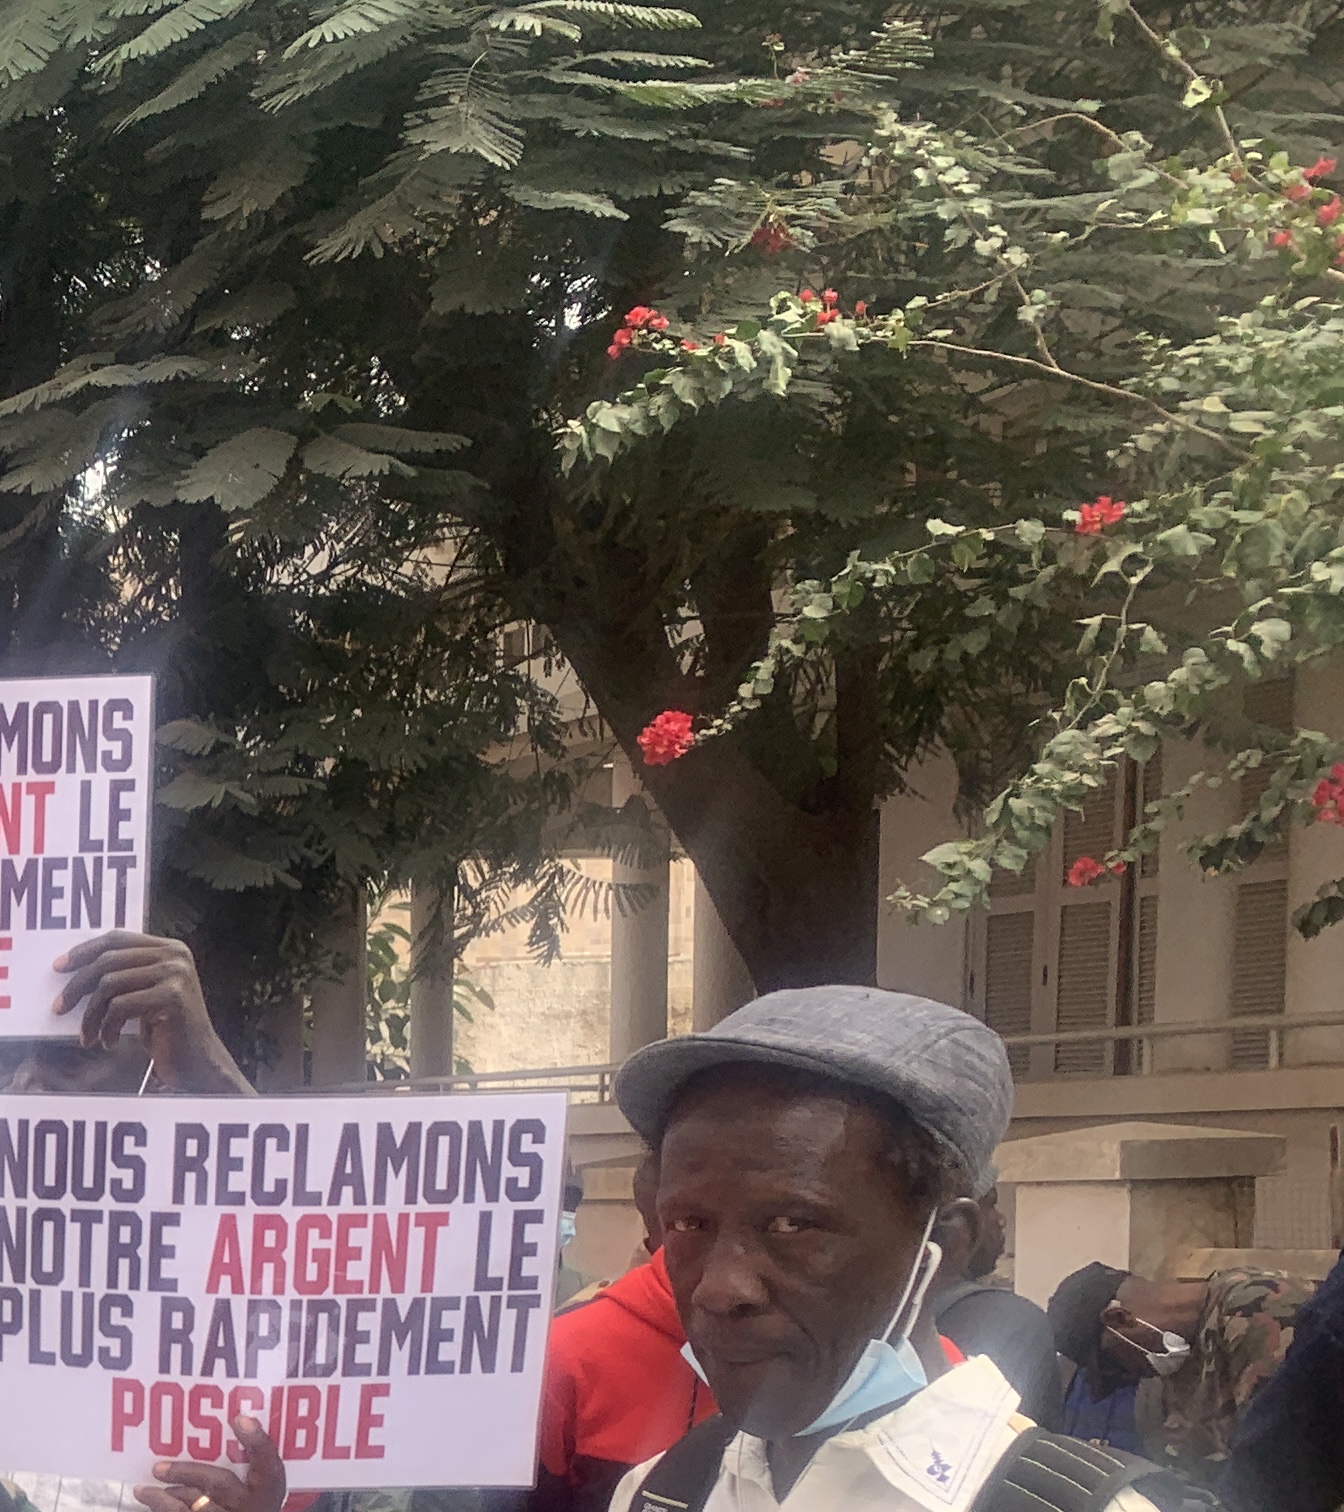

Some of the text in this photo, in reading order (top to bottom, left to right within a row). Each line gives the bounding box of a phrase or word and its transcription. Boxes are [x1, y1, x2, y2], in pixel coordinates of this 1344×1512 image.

[77, 778, 136, 854] LE
[171, 1117, 547, 1207] RECLAMONS
[205, 1211, 450, 1296] ARGENT
[473, 1208, 546, 1294] LE
[158, 1293, 541, 1379] RAPIDEMENT
[110, 1377, 391, 1465] POSSIBLE
